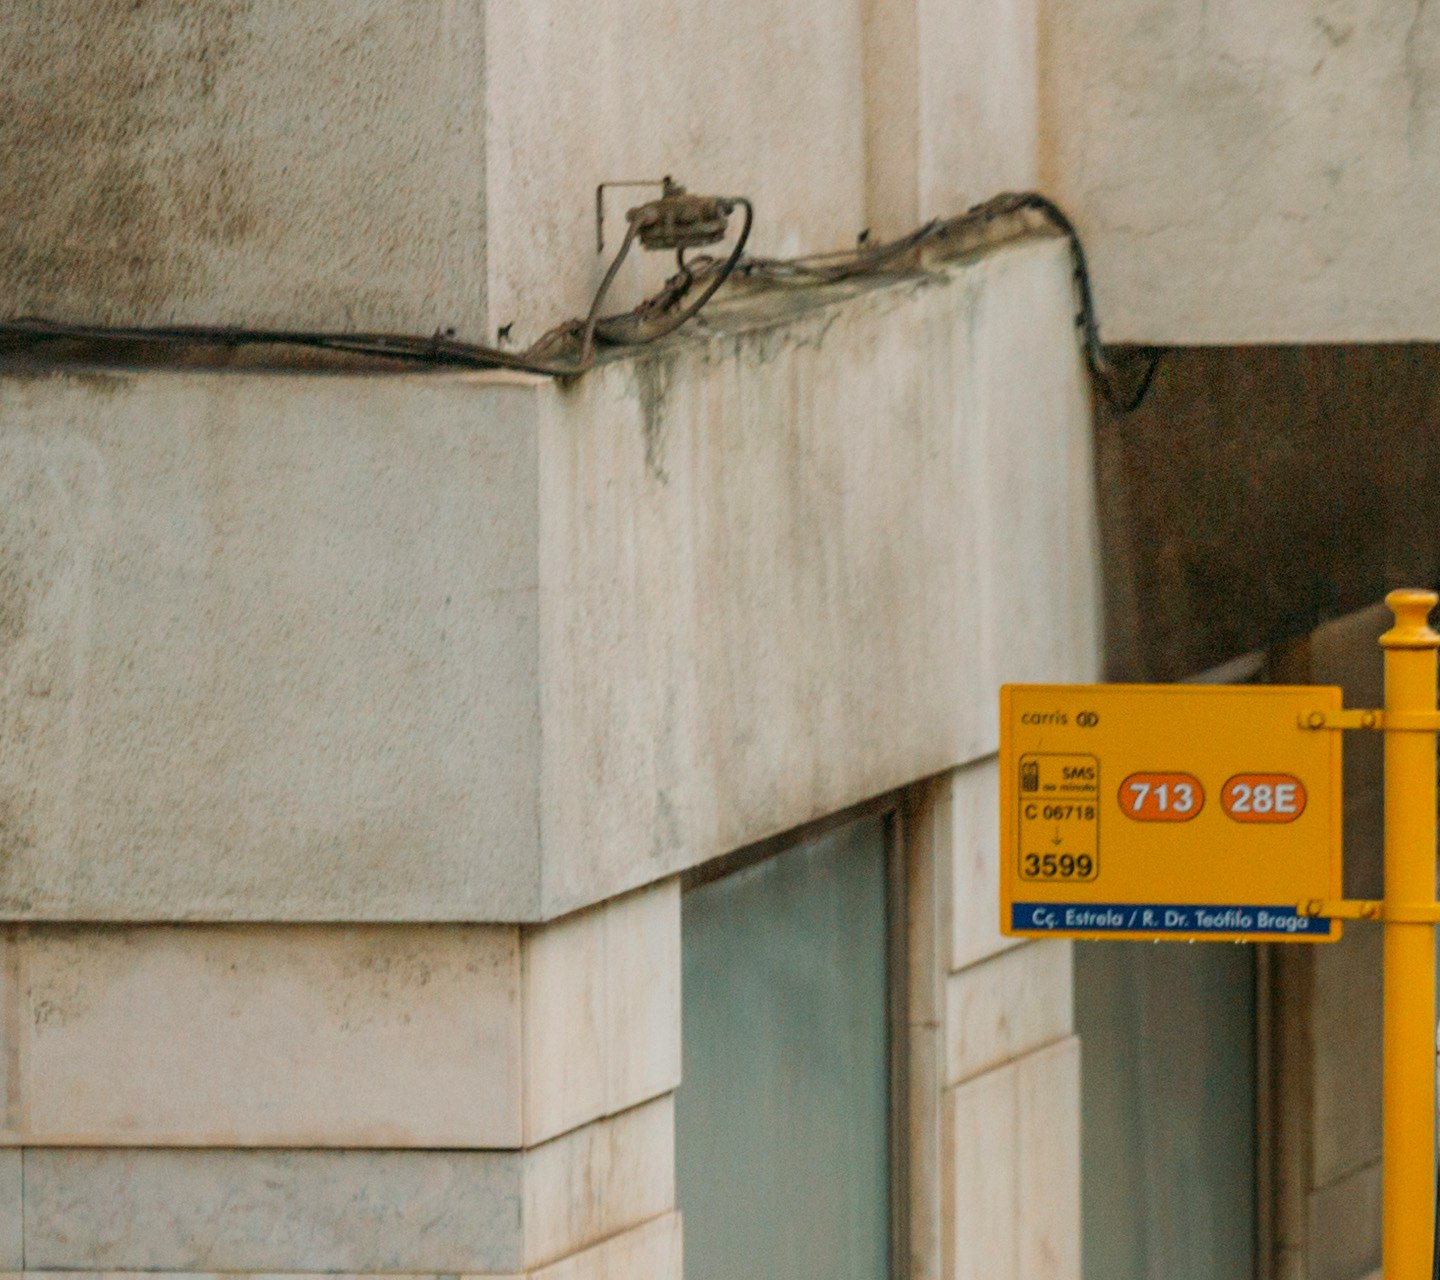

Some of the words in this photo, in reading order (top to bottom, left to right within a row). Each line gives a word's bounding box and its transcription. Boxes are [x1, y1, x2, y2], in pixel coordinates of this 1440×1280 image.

[1021, 710, 1068, 726] carris
[1062, 766, 1095, 780] SMS
[1128, 782, 1195, 812] 713
[1230, 783, 1297, 813] 28E
[1024, 804, 1038, 820] C
[1043, 804, 1095, 820] 06718
[1024, 853, 1093, 878] 3599
[1031, 908, 1059, 930] Cç.
[1065, 909, 1122, 927] Estrela
[1142, 910, 1158, 927] R.
[1164, 910, 1189, 928] Dr.
[1195, 908, 1252, 929] Teófilo
[1257, 910, 1310, 933] Braga
